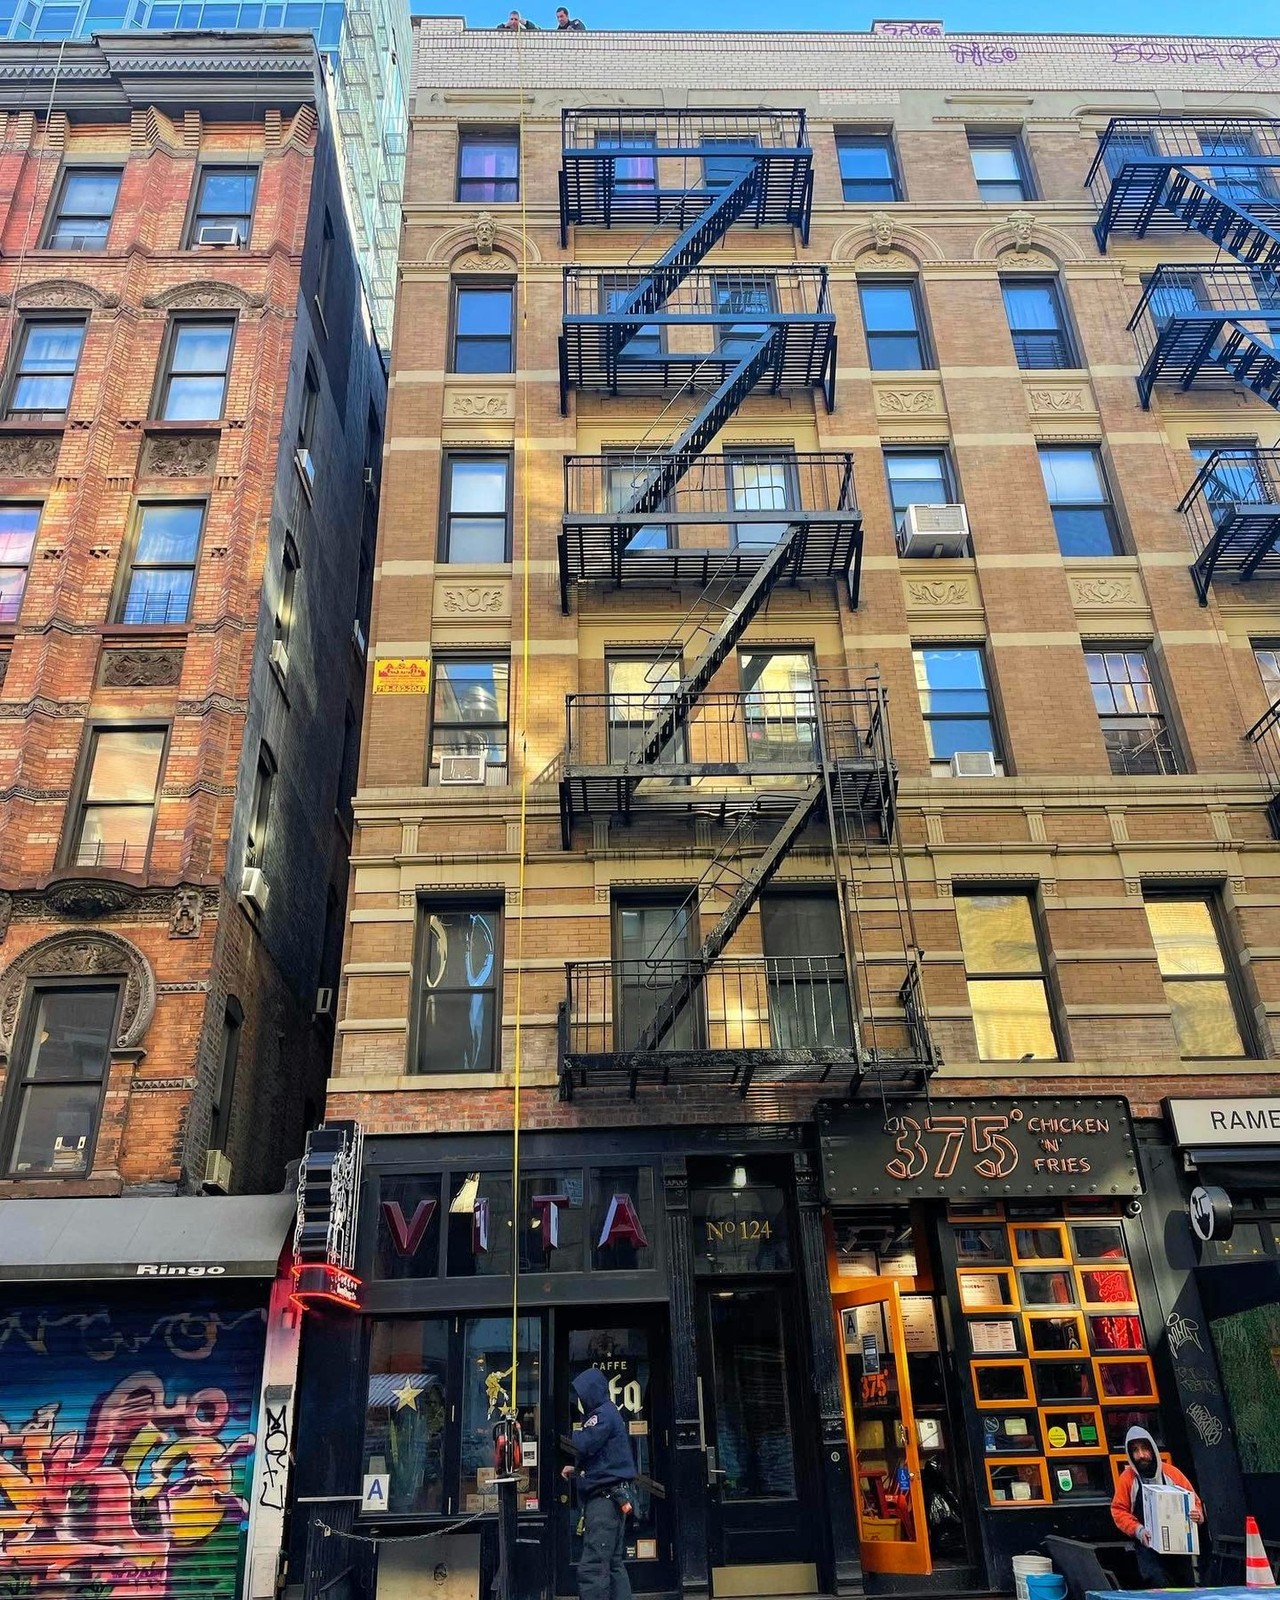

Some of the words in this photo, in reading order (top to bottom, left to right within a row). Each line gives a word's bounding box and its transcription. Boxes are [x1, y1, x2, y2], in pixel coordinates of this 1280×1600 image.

[1027, 1117, 1110, 1134] CHICKEN
[1033, 1157, 1091, 1173] FRIES
[381, 1193, 648, 1256] VITA
[740, 1220, 773, 1239] 124
[136, 1264, 226, 1276] Ringo
[592, 1361, 627, 1371] CAFFE
[367, 1479, 384, 1500] A
